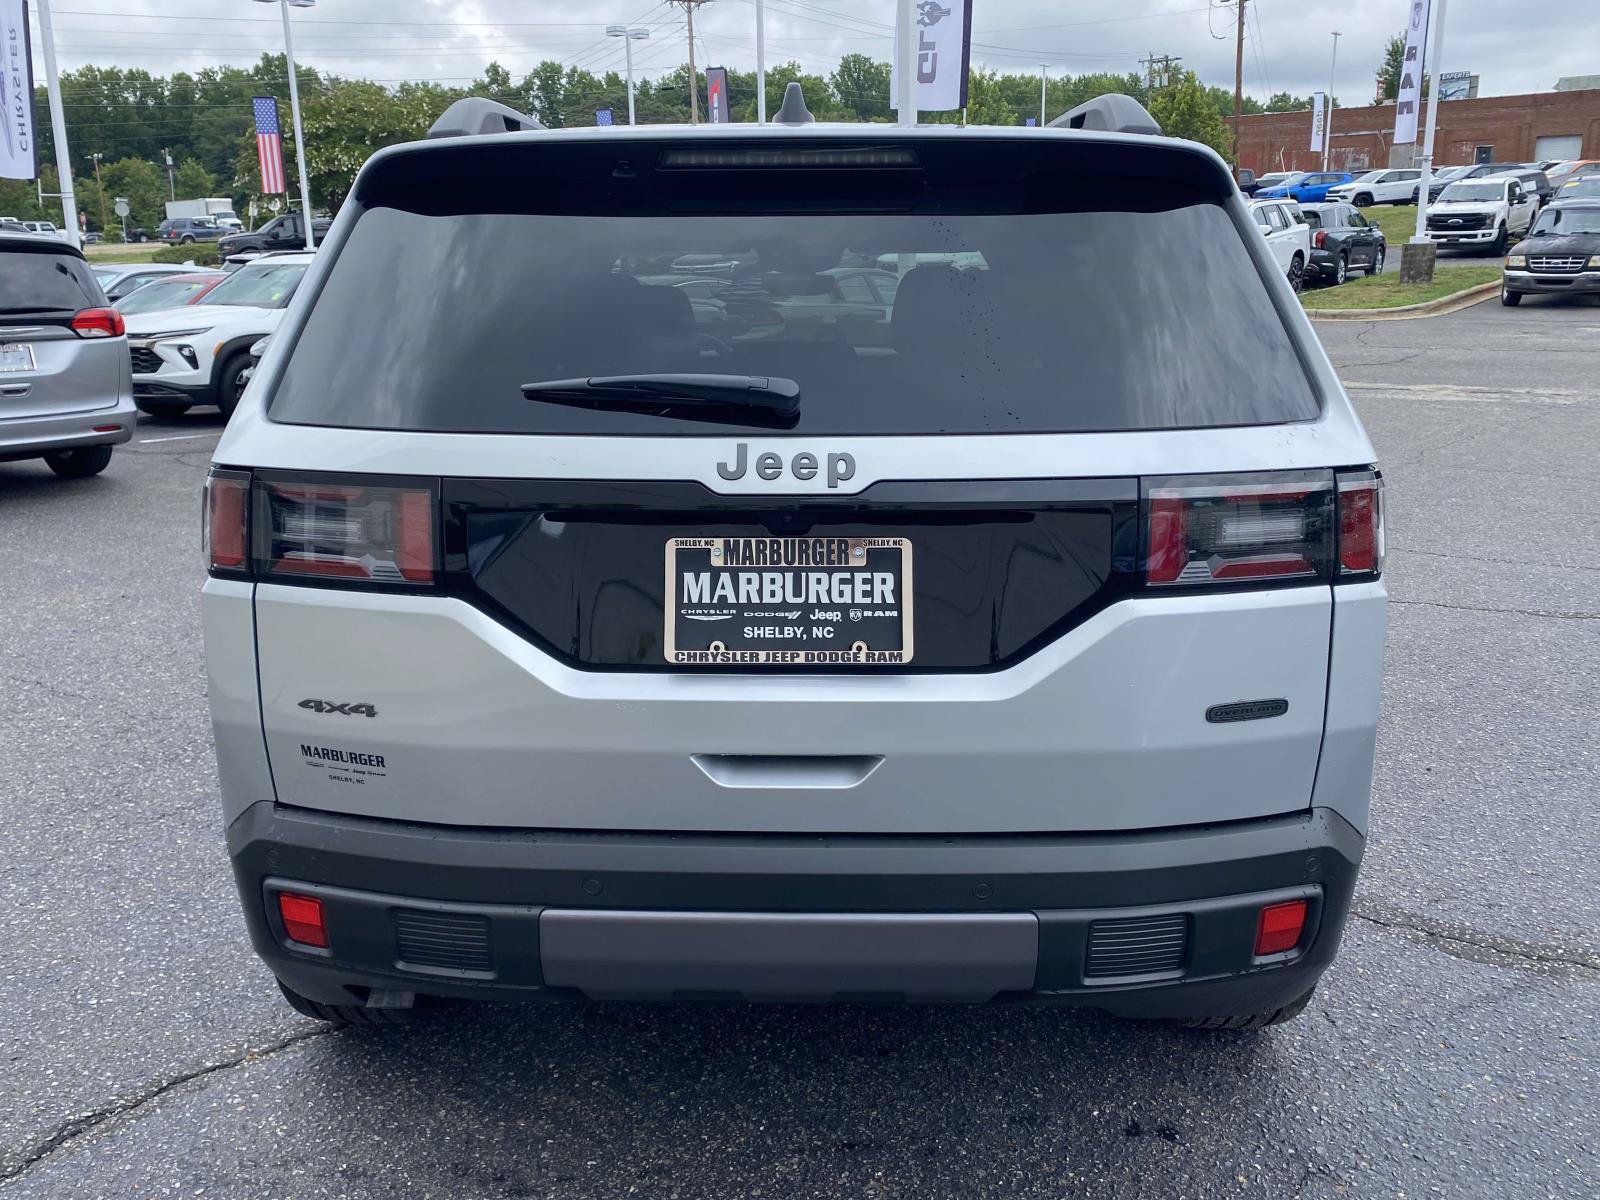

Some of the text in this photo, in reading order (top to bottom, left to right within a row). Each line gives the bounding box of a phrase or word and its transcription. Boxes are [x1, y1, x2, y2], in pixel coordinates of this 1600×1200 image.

[1441, 71, 1471, 80] EXPERTS
[716, 442, 857, 489] Jeep
[703, 539, 715, 547] NC
[892, 539, 904, 547] NC
[723, 538, 851, 566] MARBURGER
[682, 571, 896, 605] MARBURGER
[809, 609, 842, 622] Jeep
[743, 626, 835, 640] SHELBY, NC
[674, 651, 904, 663] CHRYSLER JEEP DODGE RAM
[298, 697, 378, 718] 4x4
[1214, 705, 1282, 716] OVERLAND
[300, 744, 386, 768] MARBURGER
